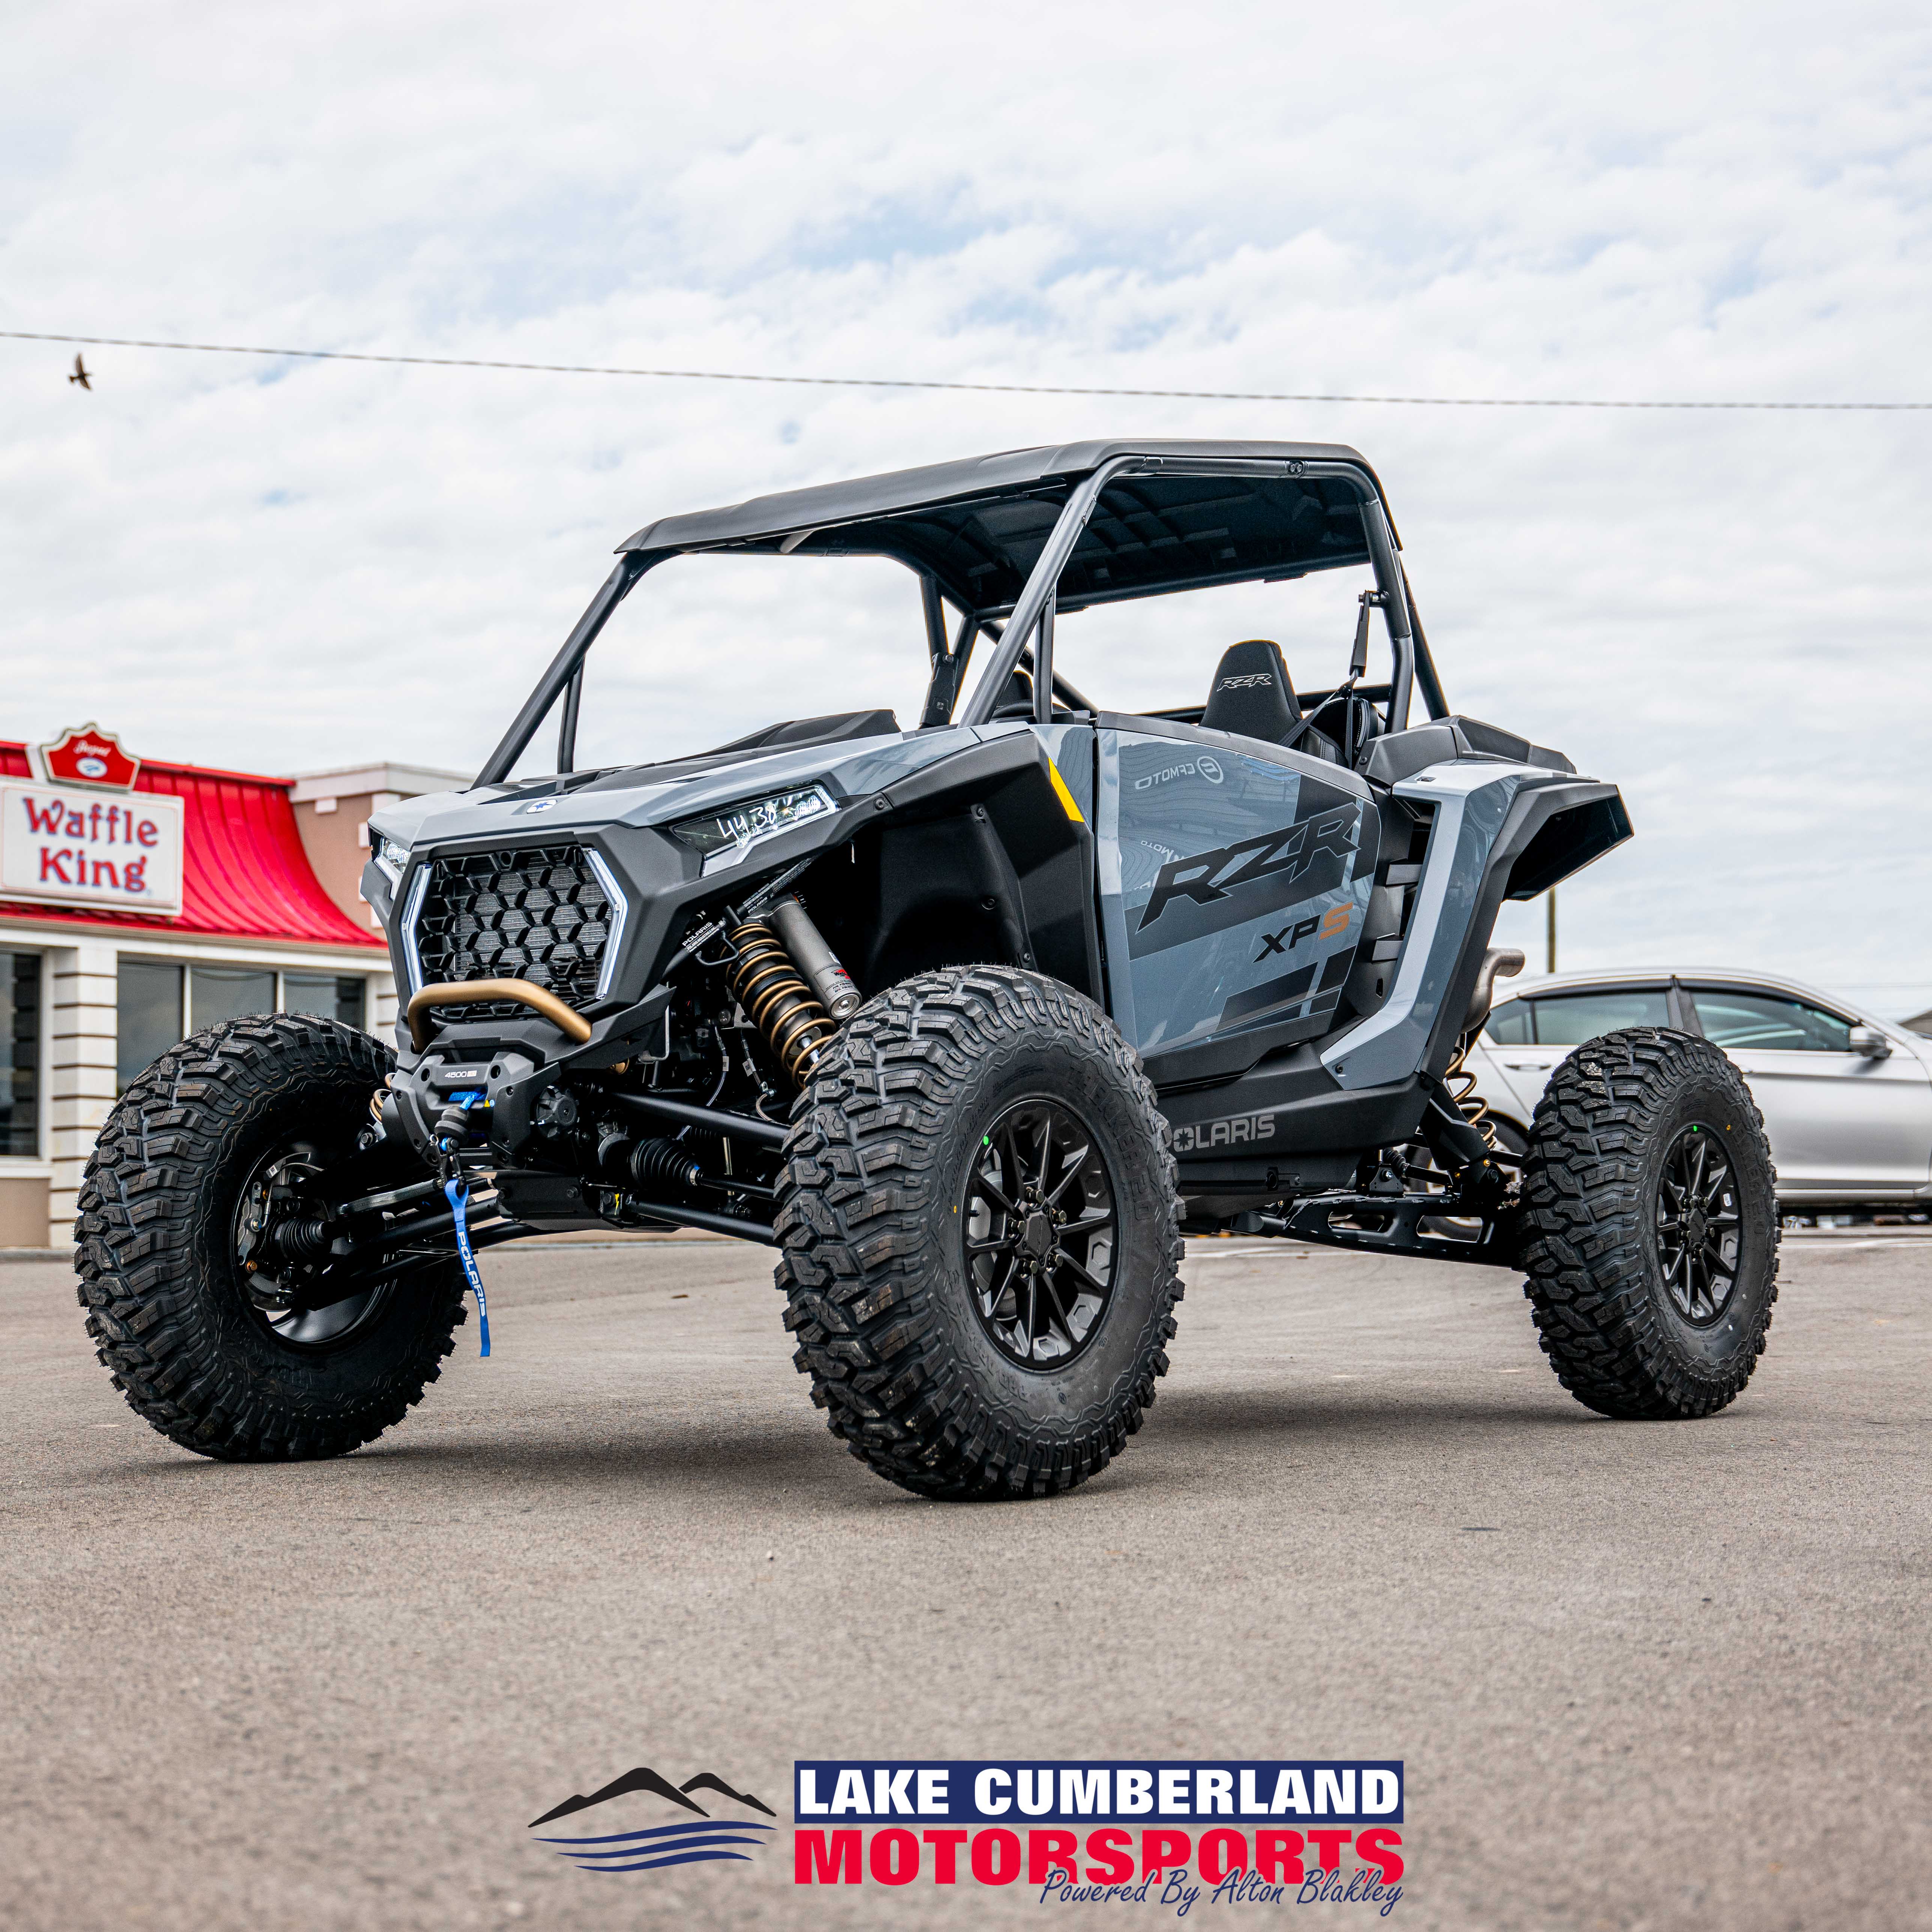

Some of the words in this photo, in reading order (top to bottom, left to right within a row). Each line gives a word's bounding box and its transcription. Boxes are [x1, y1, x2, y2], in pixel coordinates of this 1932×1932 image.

[1216, 674, 1272, 692] RZR
[22, 797, 159, 848] Waffle
[39, 846, 147, 893] King
[1135, 802, 1362, 935] RZR
[748, 897, 768, 913] POLARIS
[682, 922, 712, 946] POLARIS
[687, 941, 698, 950] POLARIS
[458, 1231, 486, 1317] POLARIS
